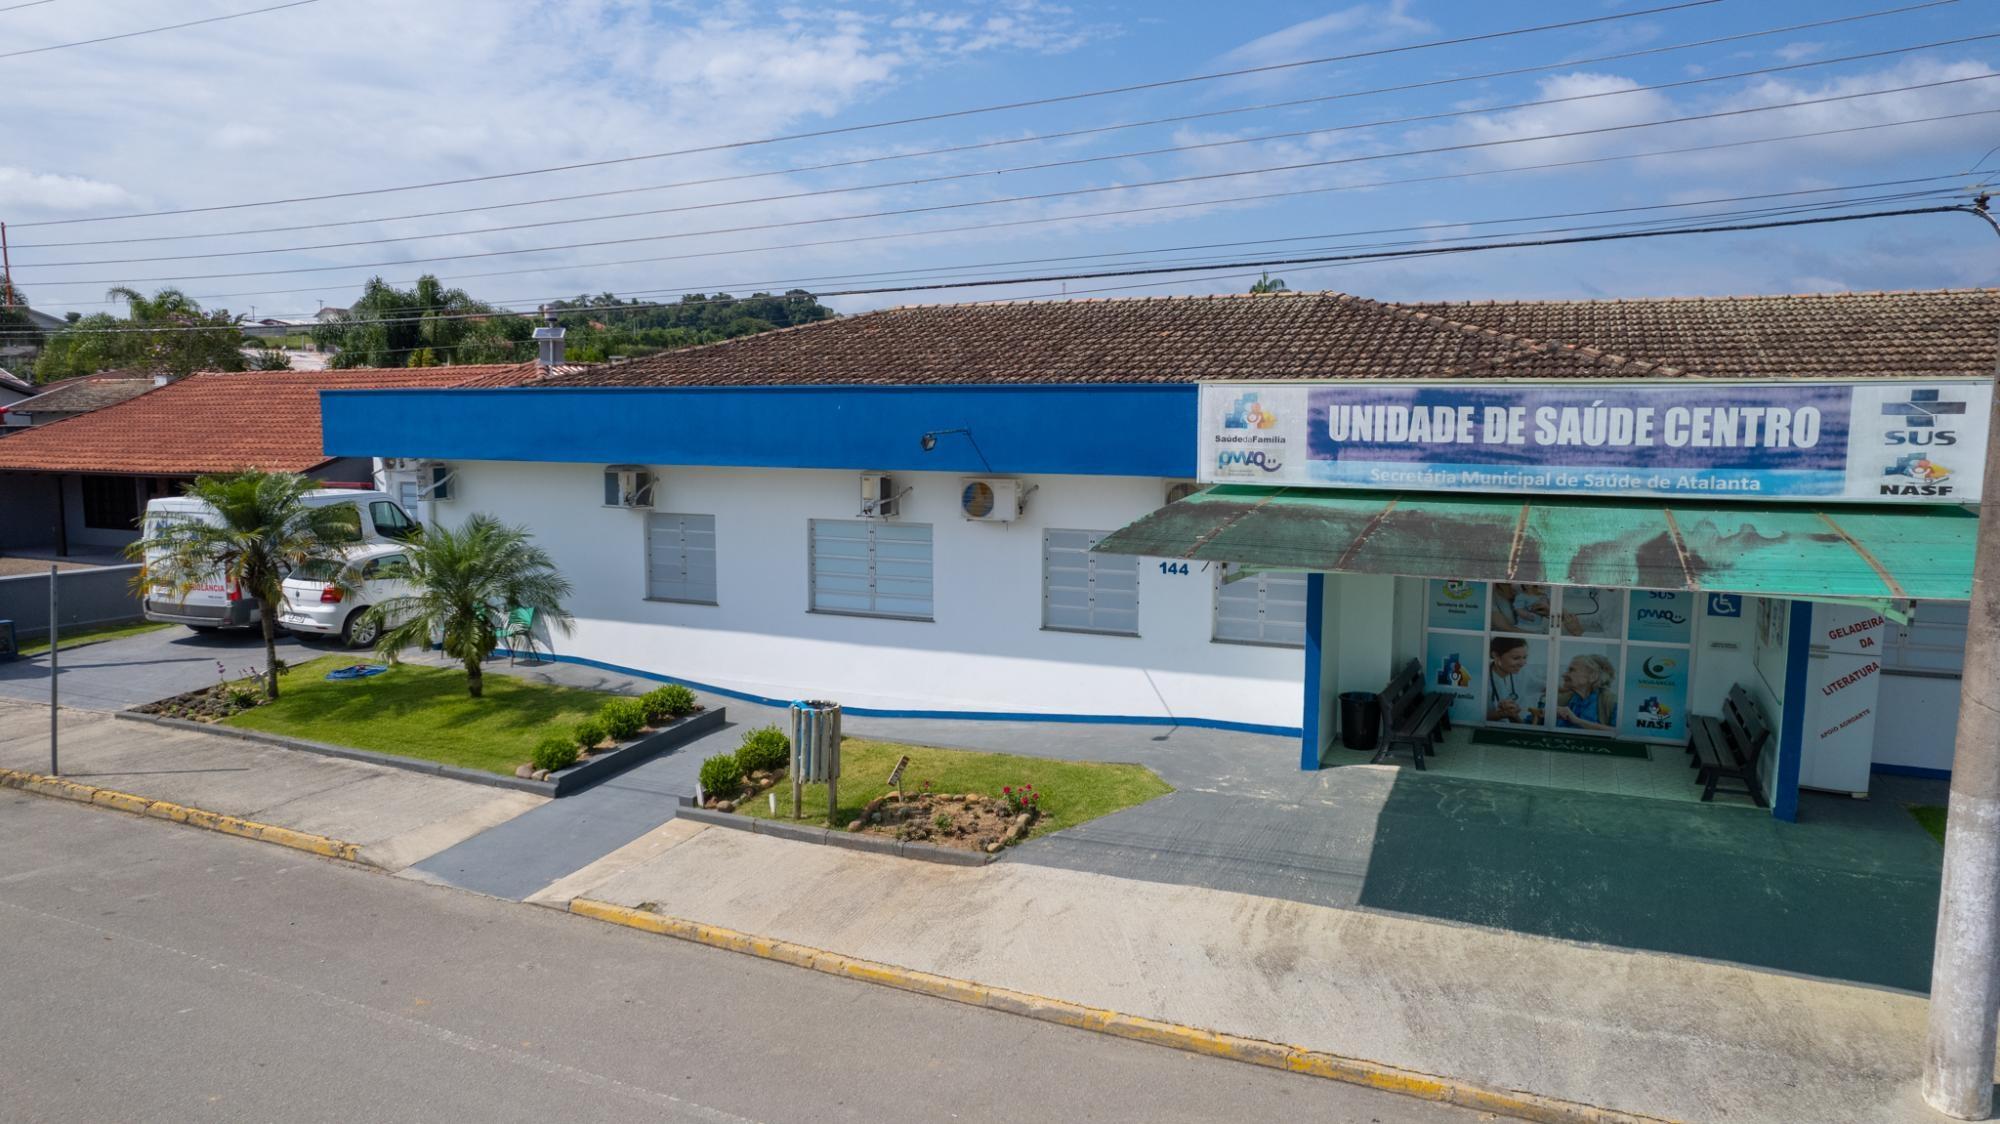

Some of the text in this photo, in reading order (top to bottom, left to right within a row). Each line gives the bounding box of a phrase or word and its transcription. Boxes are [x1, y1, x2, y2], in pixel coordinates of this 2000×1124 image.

[1328, 399, 1821, 449] UNIDADE DE SAÚDE CENTRO
[1884, 429, 1957, 446] SUS
[1370, 466, 1761, 491] Secretária Municipal de Saúde de Atalanta
[1879, 484, 1954, 496] NASF
[1158, 561, 1189, 576] 144
[1828, 615, 1885, 641] GELADEIRA
[1859, 636, 1875, 649] DA
[1821, 661, 1880, 697] LITERATURA
[1636, 719, 1673, 730] NASF
